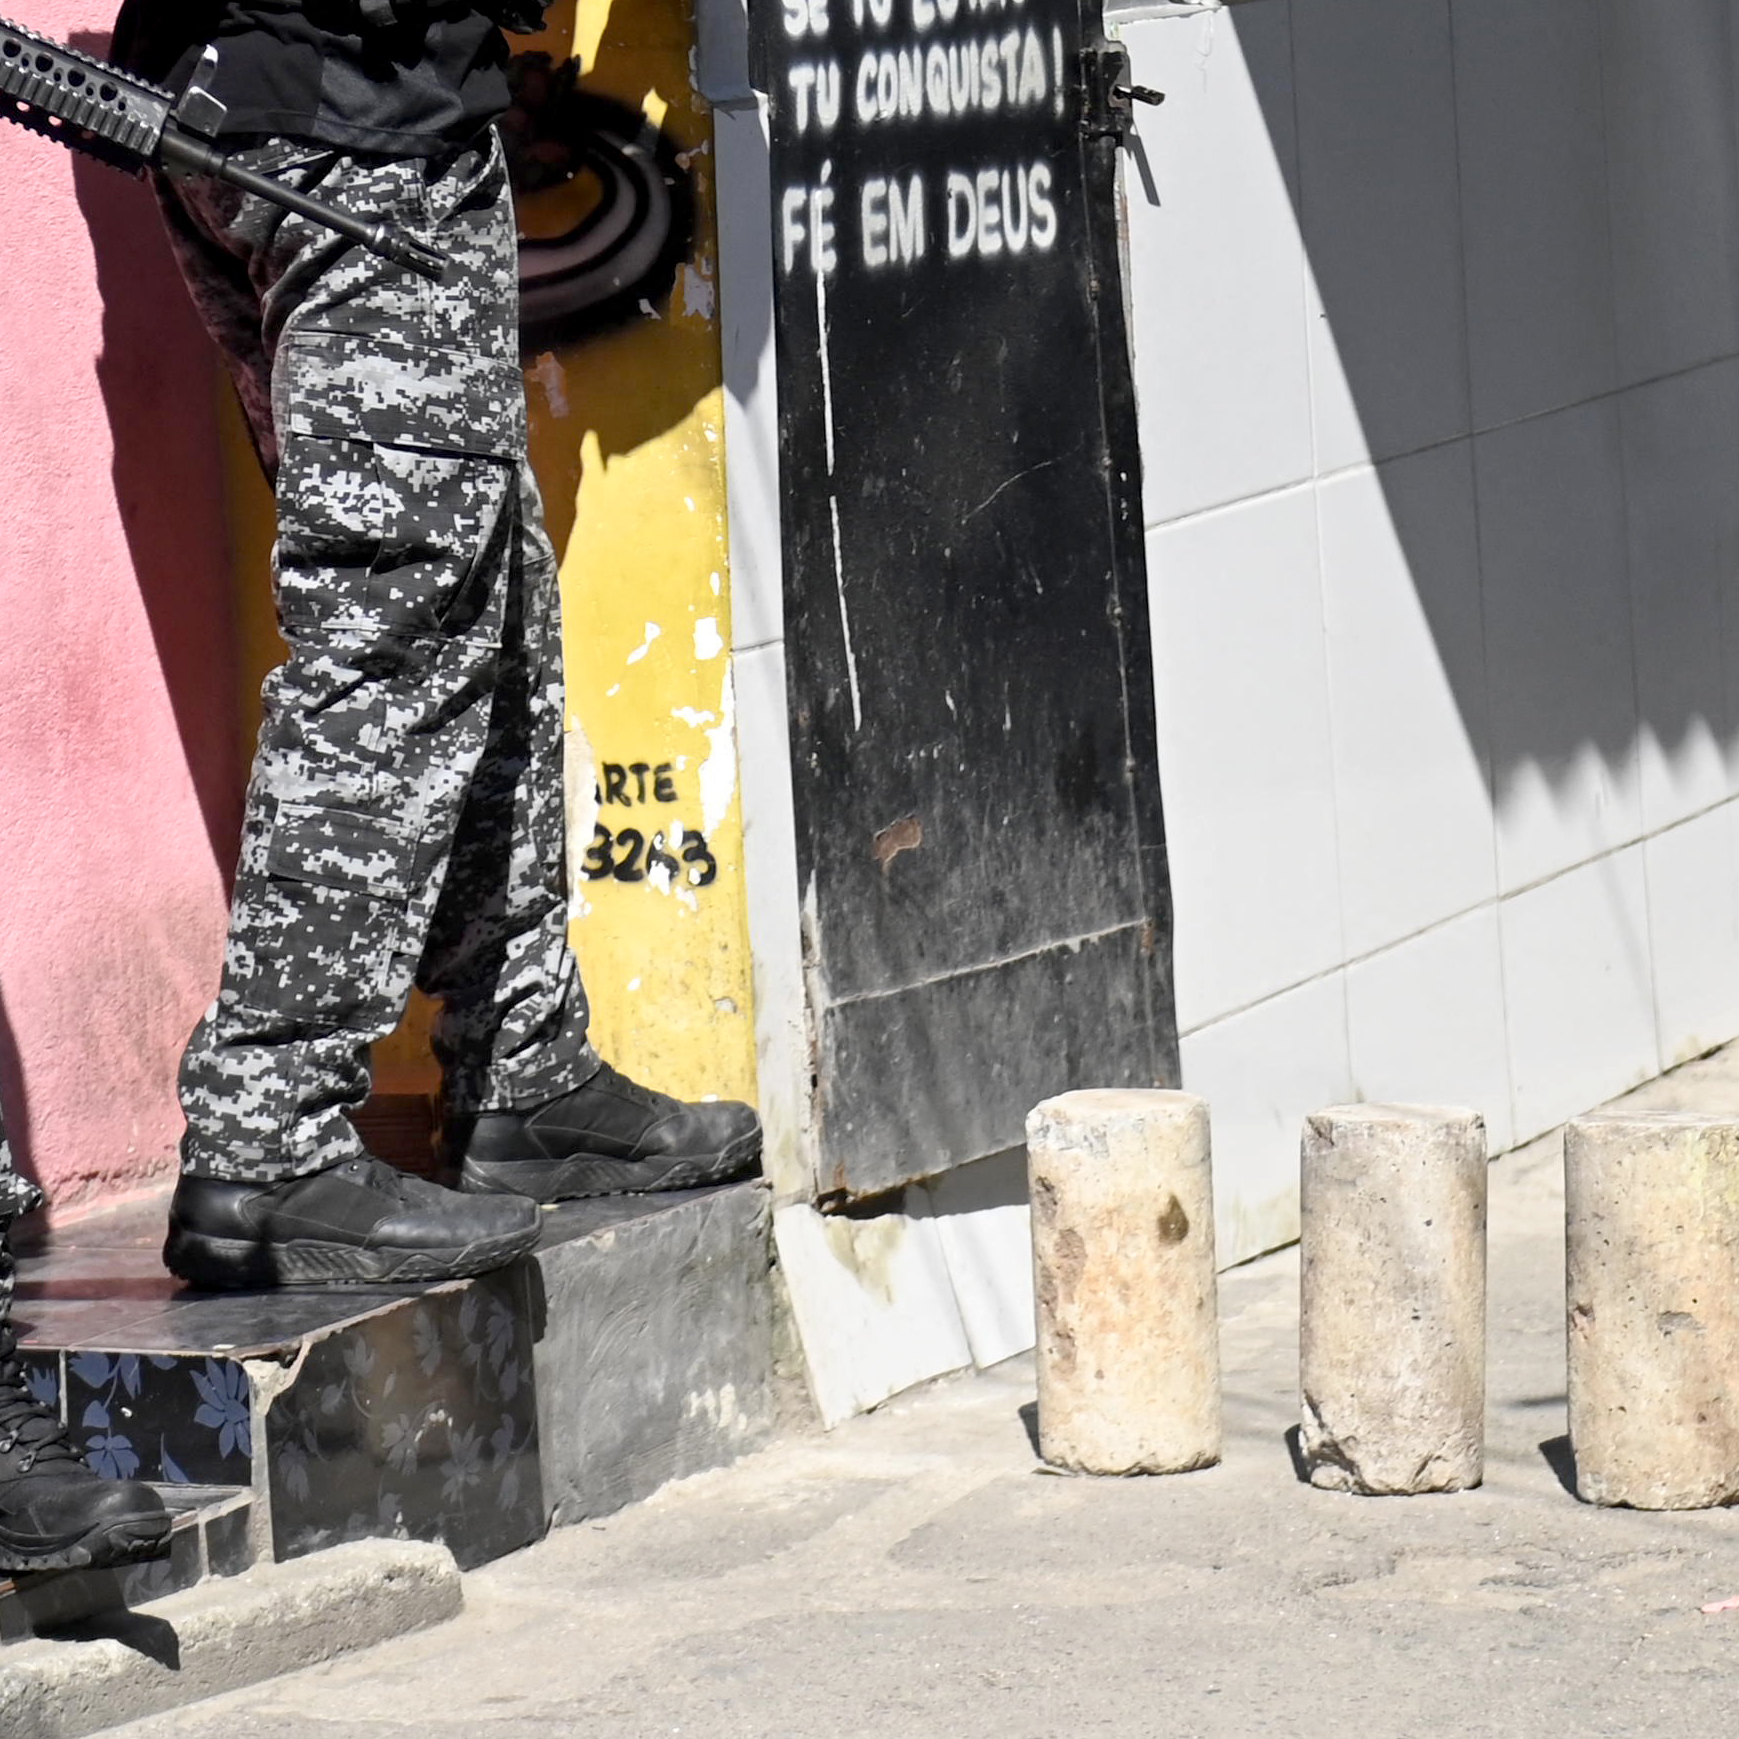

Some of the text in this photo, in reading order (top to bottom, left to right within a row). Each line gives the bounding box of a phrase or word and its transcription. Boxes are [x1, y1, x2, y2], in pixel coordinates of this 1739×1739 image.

[788, 24, 1065, 133] TU CONQUISTA!
[781, 159, 1058, 275] FÉ EM DEUS
